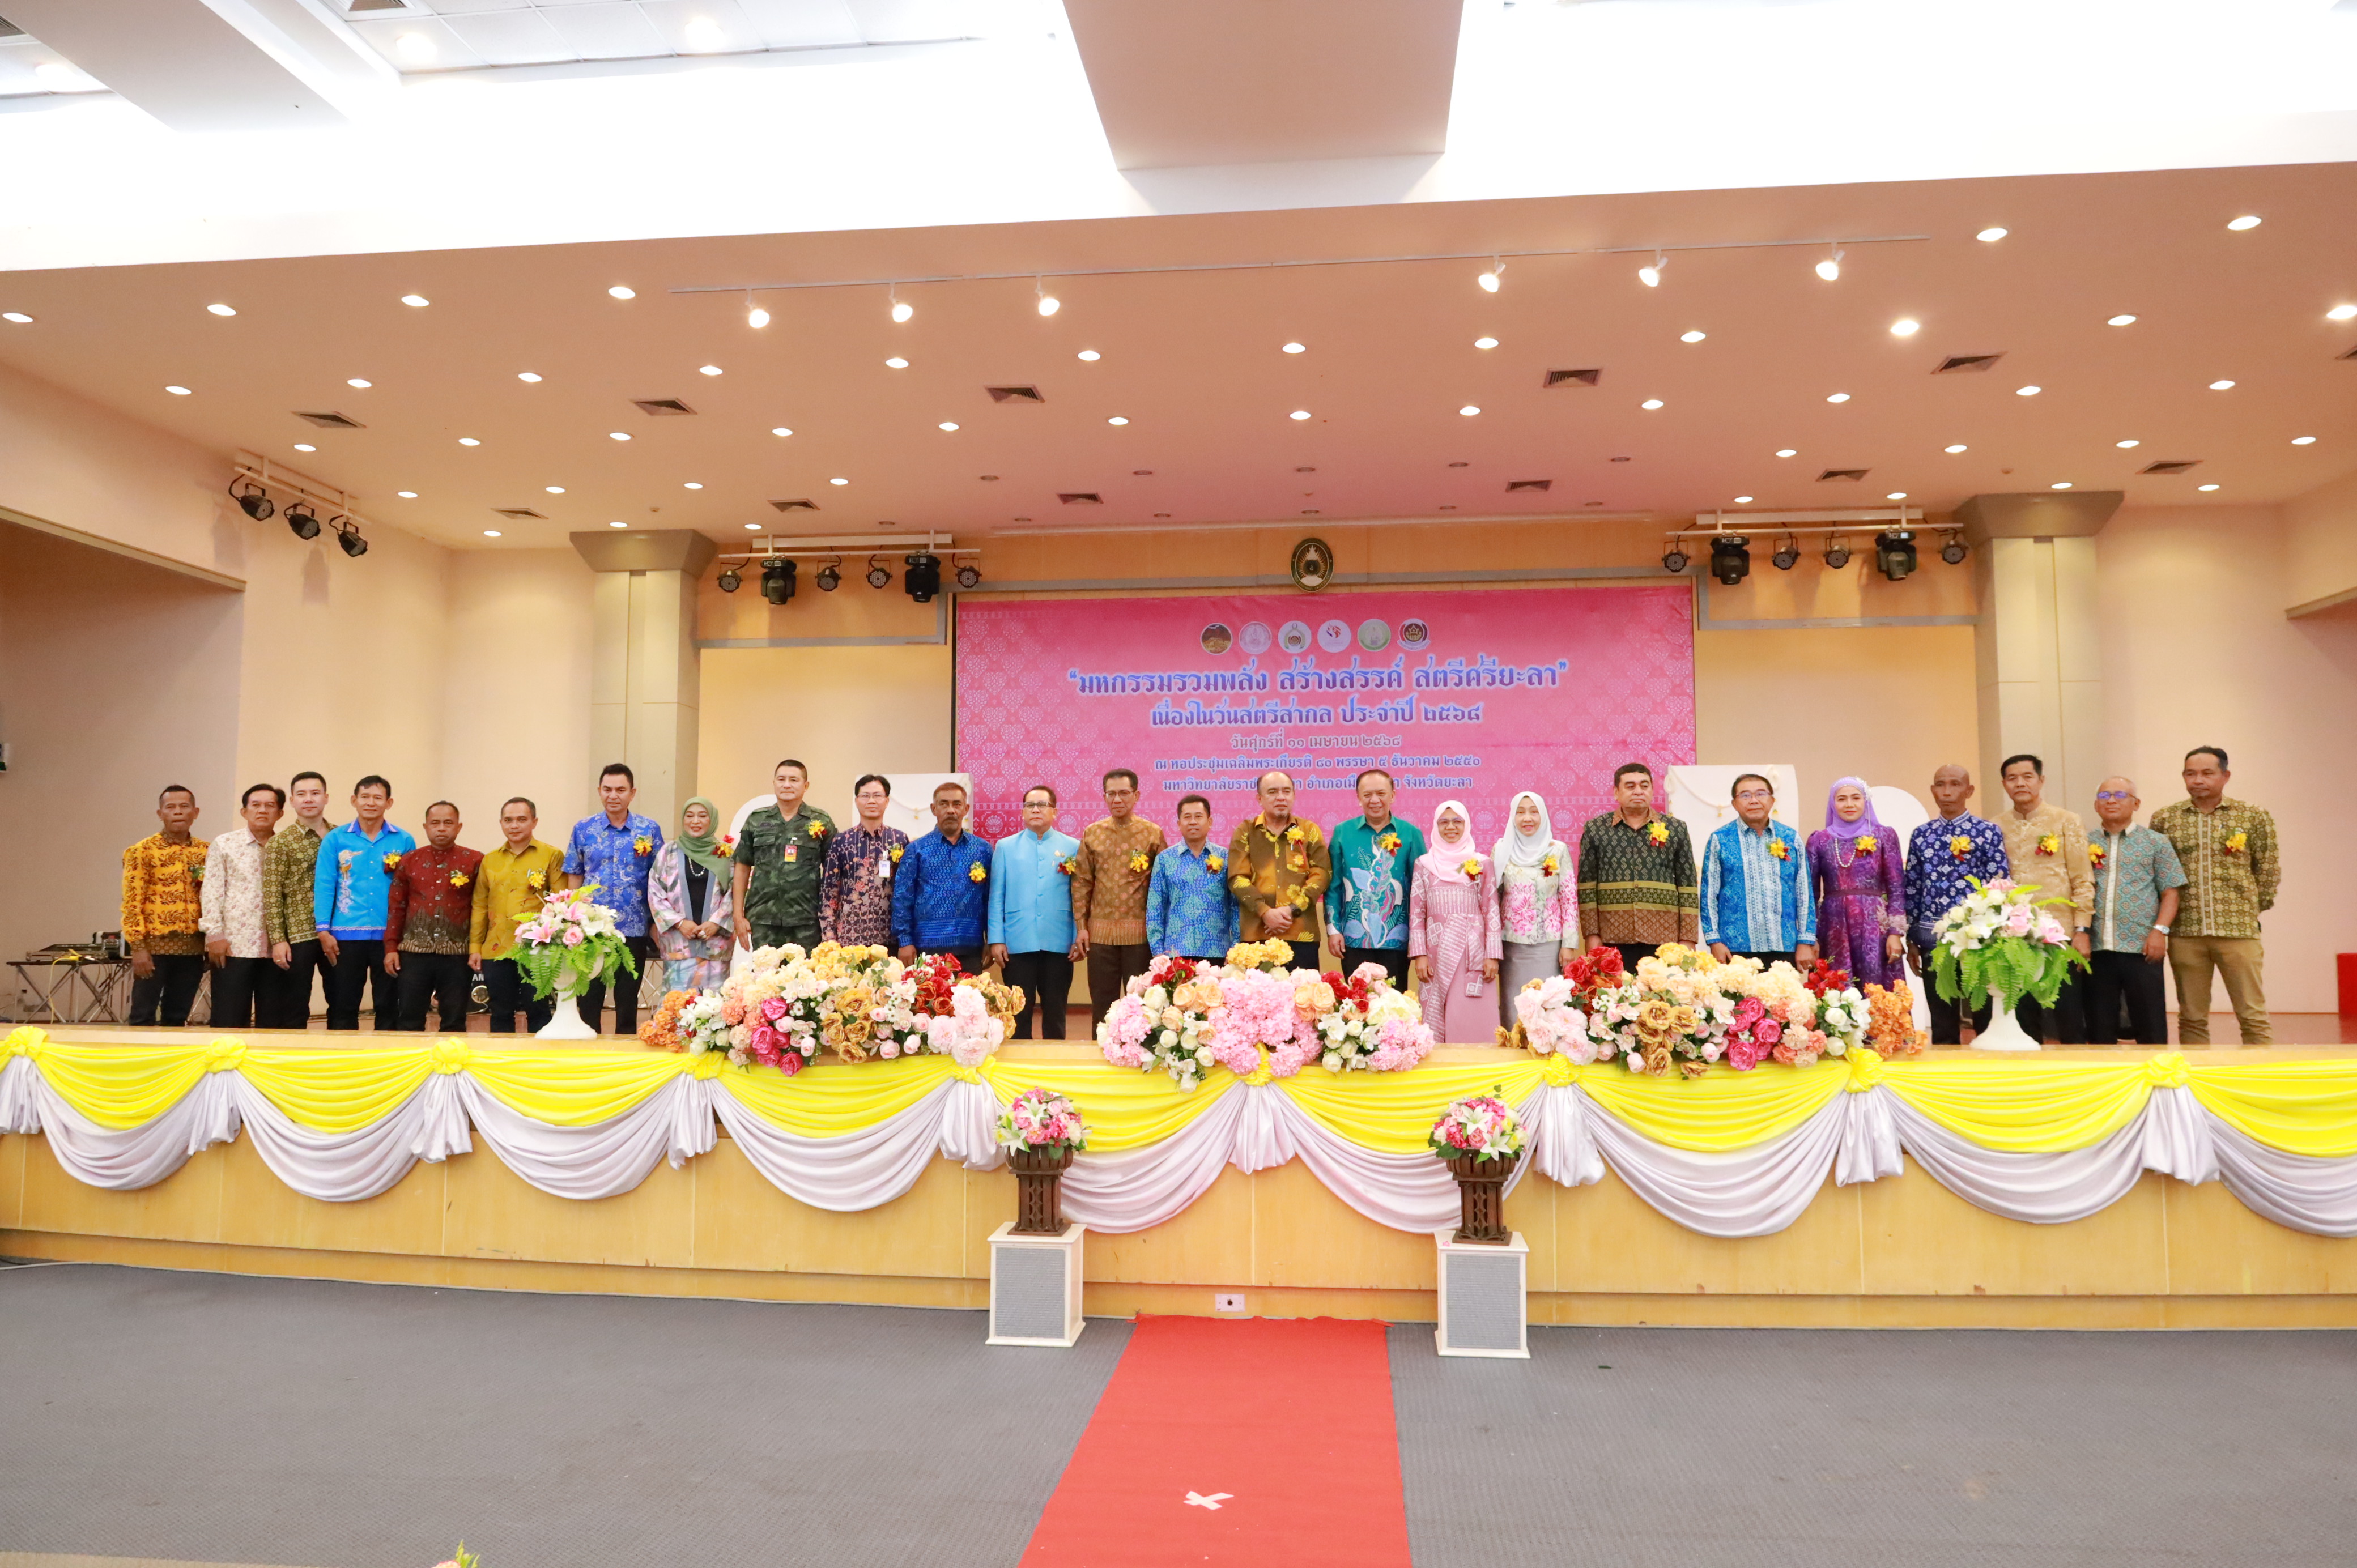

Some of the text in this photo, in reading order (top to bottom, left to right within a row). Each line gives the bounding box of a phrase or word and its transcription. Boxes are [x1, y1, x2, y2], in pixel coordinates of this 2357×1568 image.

[1279, 656, 1404, 690] สร้างสรรค์
[1152, 695, 1481, 725] เนื่องในวันสตรีสากล ประจำปี ๒๕๖๘
[1232, 728, 1401, 751] วันศุกร์ที่ ๑๑ เมษายน ๒๕๖๘
[1155, 754, 1480, 773] ณ หอประชุมเฉลิมพระเกียรติ ๘๐ พรรษา ๕ ธันวาคม ๒๕๕๐
[1404, 775, 1472, 787] จังหวัดยะลา
